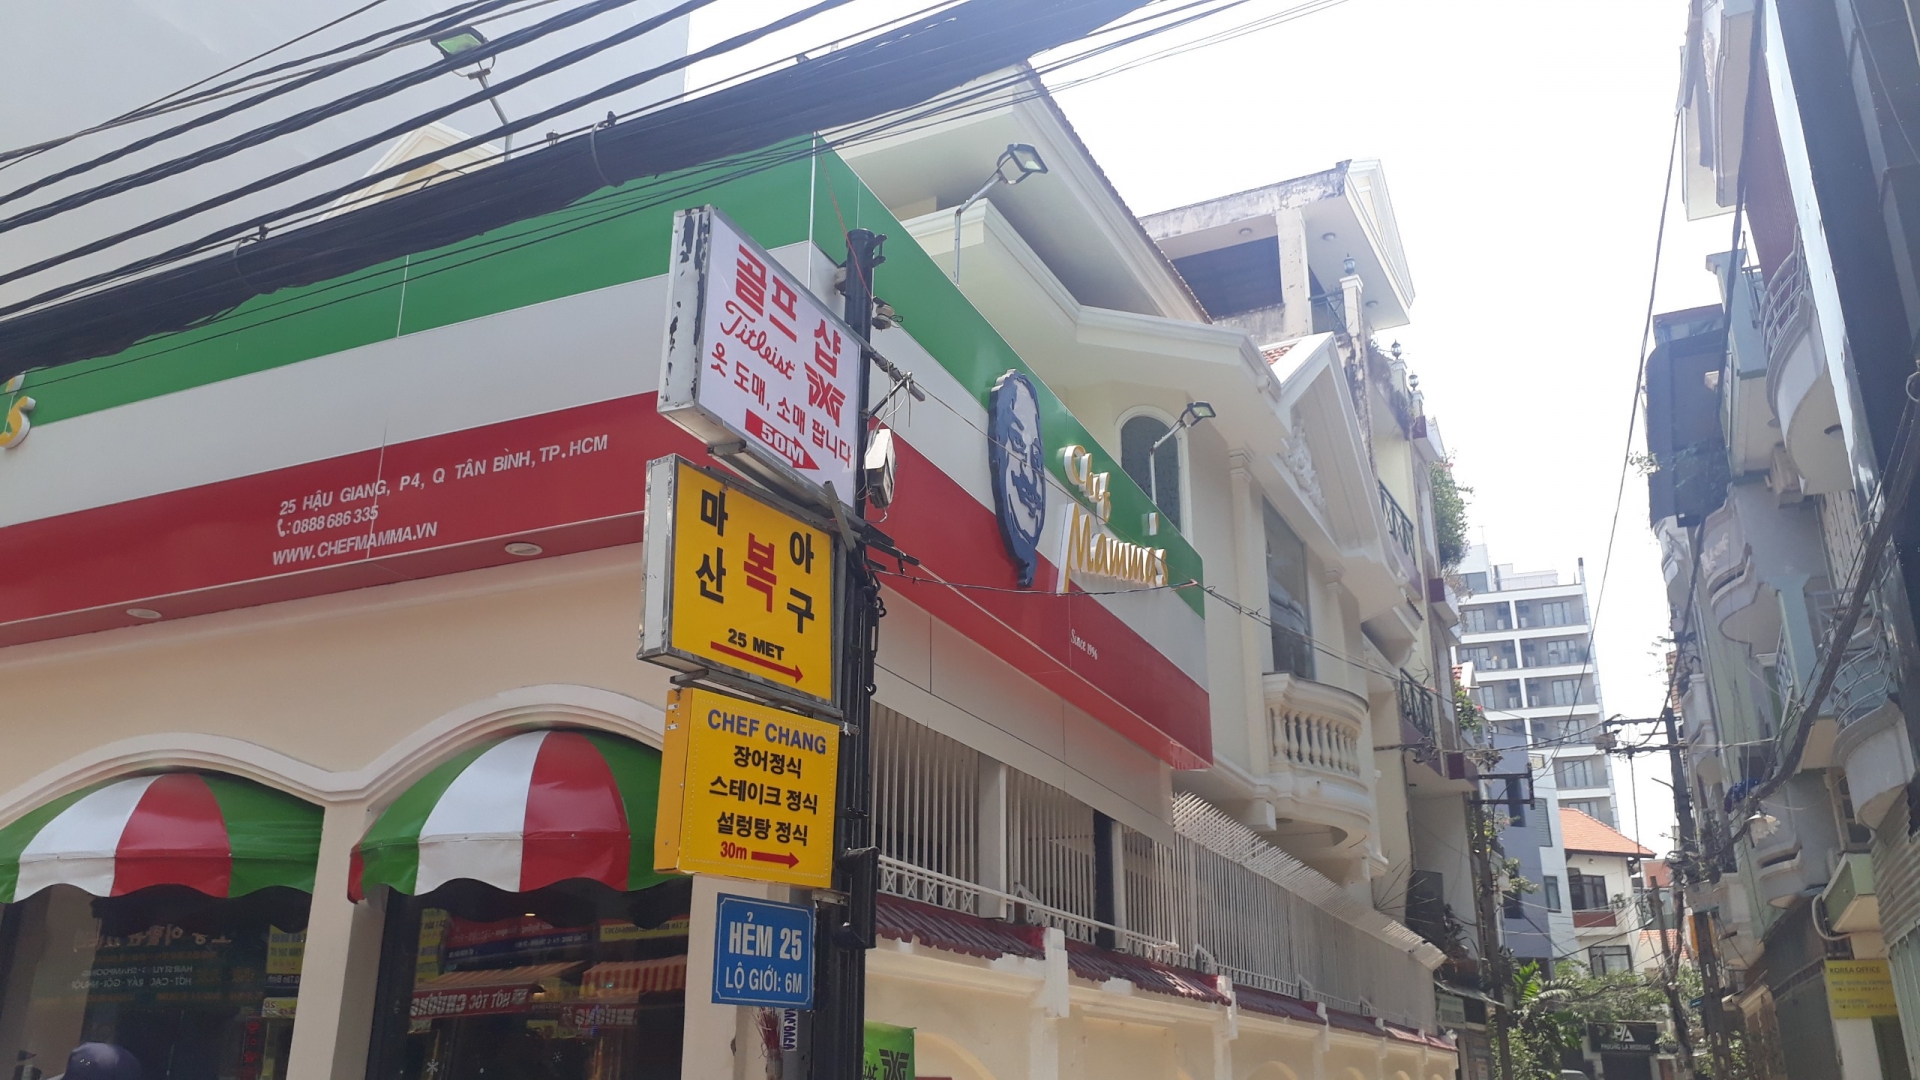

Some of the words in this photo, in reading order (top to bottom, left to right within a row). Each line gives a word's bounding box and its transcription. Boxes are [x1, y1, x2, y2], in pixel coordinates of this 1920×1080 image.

[735, 243, 798, 344] 골프
[813, 318, 842, 378] 샵
[720, 299, 796, 380] Titleist
[710, 341, 728, 378] 옷
[733, 360, 770, 411] 도매,
[776, 396, 806, 436] 소매
[812, 418, 852, 469] 팝니다
[760, 421, 805, 467] 50M
[279, 499, 297, 516] 25
[302, 489, 333, 512] HẬU
[339, 479, 391, 503] GIANG,
[399, 472, 425, 492] P4,
[432, 467, 446, 484] Q
[455, 458, 487, 480] TÂN
[492, 447, 536, 473] BÌNH,
[539, 434, 608, 462] TP.HCM
[326, 510, 352, 529] 686
[353, 504, 379, 524] 335
[272, 521, 438, 566] WWW.CHEFMAMMA.VN
[743, 532, 777, 613] 복
[727, 628, 747, 648] 25
[753, 636, 785, 661] MET
[1070, 628, 1086, 652] Since
[707, 709, 760, 737] CHEF
[764, 723, 827, 755] CHANG
[733, 745, 802, 779] 장어정식
[709, 775, 782, 806] 스테이크
[785, 789, 818, 815] 정식
[716, 811, 772, 840] 설렁탕
[774, 821, 808, 847] 정식
[720, 840, 748, 860] 30m
[728, 911, 773, 957] HẺM
[779, 927, 802, 961] 25
[725, 961, 745, 994] LỘ
[748, 964, 781, 992] GIỚI:
[785, 972, 802, 993] 6M
